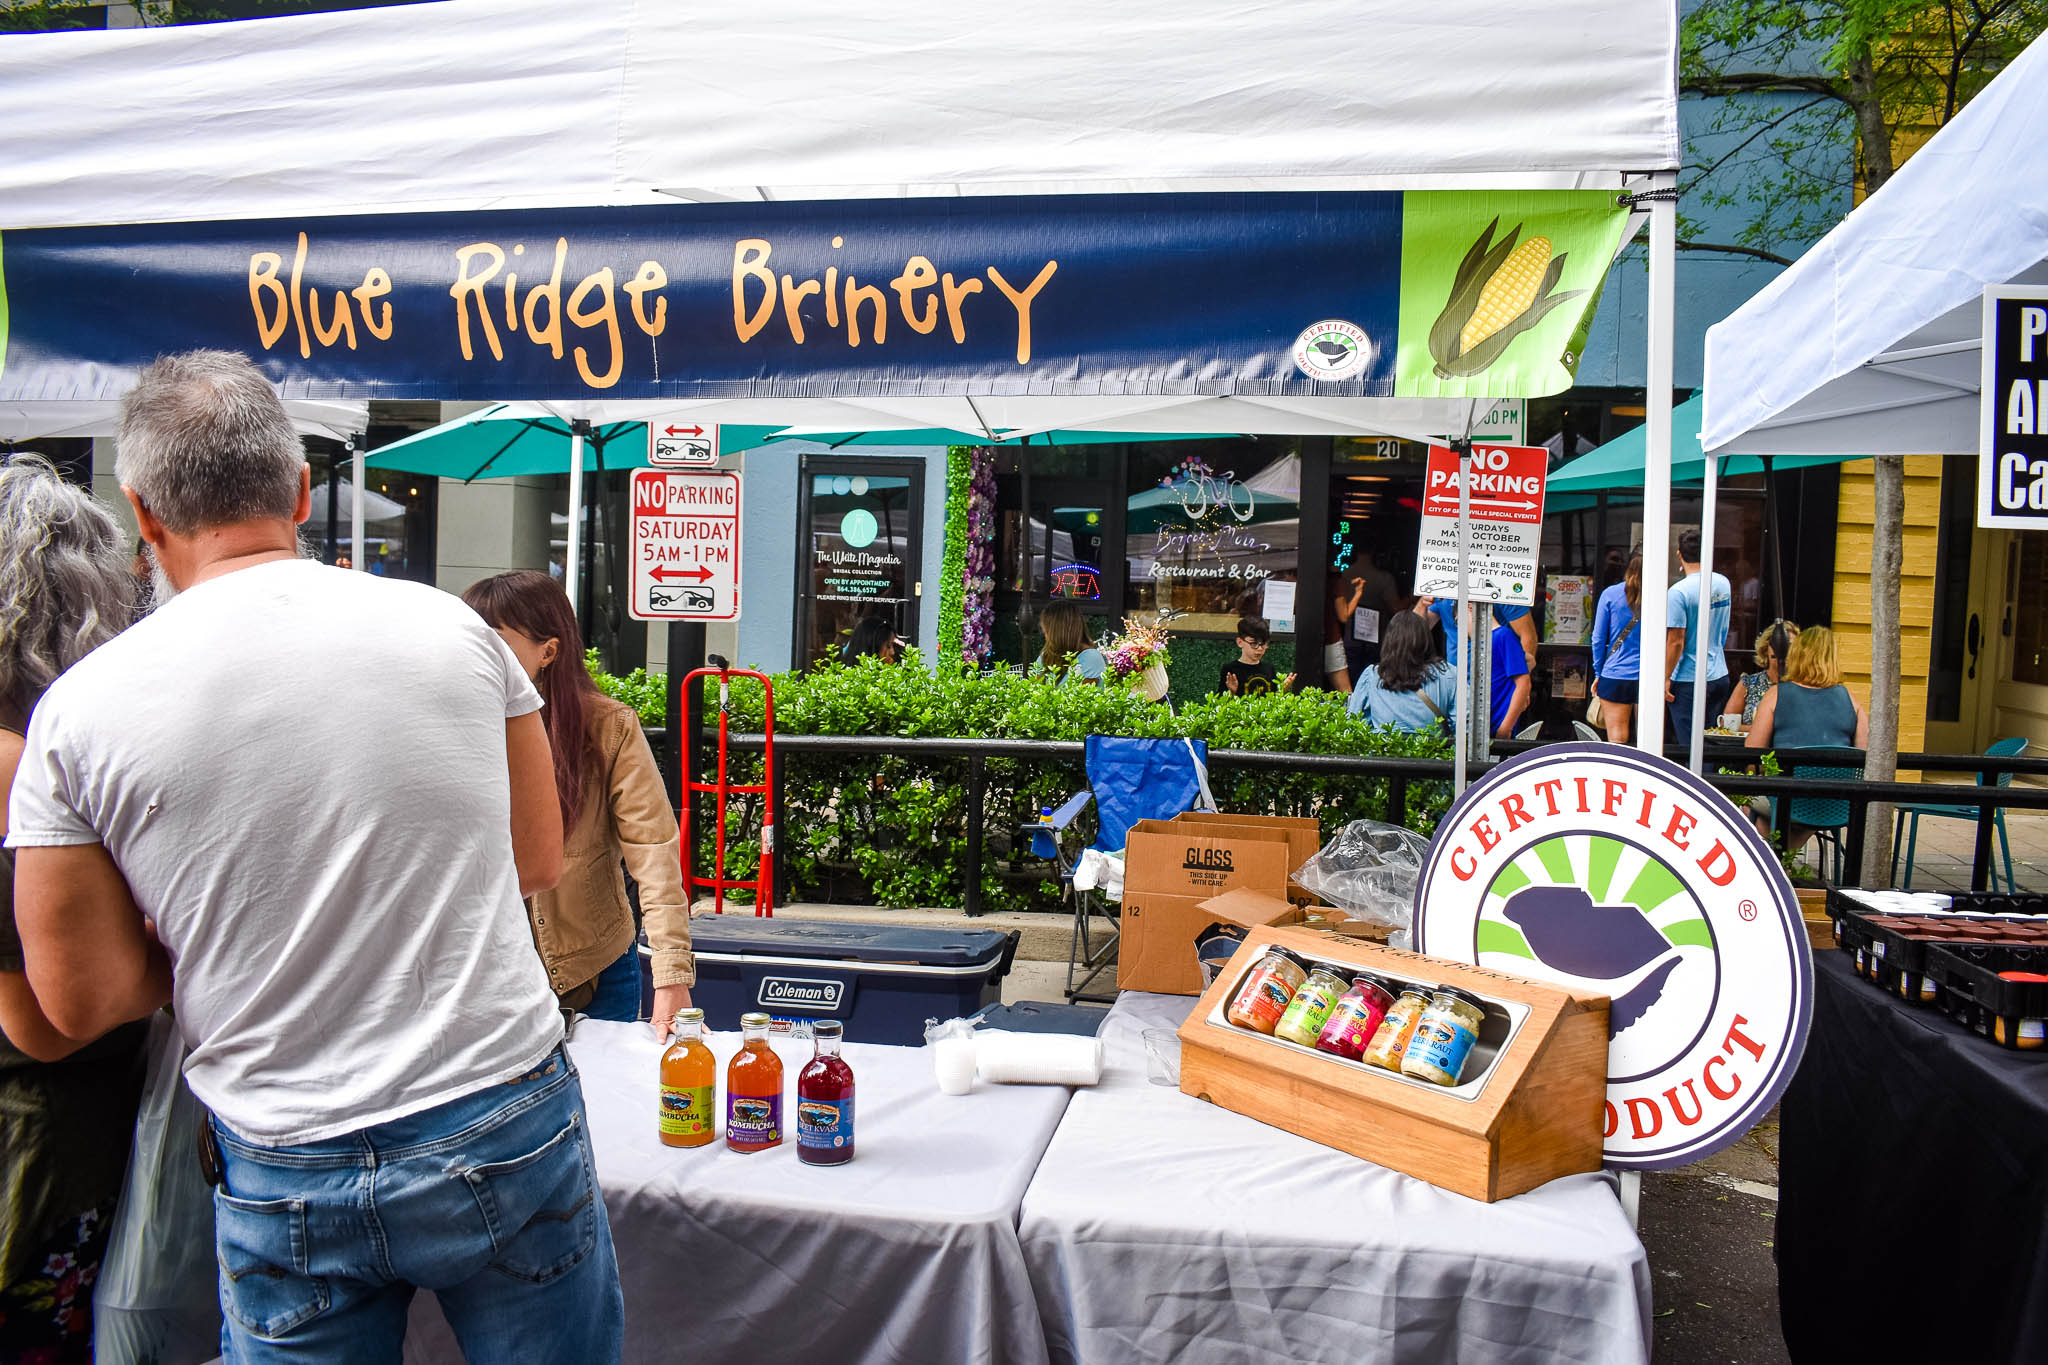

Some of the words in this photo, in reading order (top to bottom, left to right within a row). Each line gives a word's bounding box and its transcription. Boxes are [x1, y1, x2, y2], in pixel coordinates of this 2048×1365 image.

[248, 231, 393, 360] Blue
[449, 236, 668, 390] Ridge
[1303, 323, 1364, 342] CERTIFIED
[2020, 306, 2048, 363] P
[1297, 352, 1321, 377] SOUTH
[1502, 410, 1518, 424] PM
[1378, 440, 1399, 458] 20
[1470, 448, 1510, 471] NO
[1431, 470, 1540, 495] PARKING
[636, 479, 665, 509] NO
[668, 485, 734, 505] PARKING
[1452, 508, 1487, 516] GNVILLE
[1488, 510, 1513, 518] SPECIAL
[1513, 512, 1537, 520] EVENTS
[639, 520, 734, 541] SATURDAY
[1453, 521, 1510, 533] SURDAYS
[1426, 539, 1450, 547] FROM
[1485, 543, 1497, 551] TO
[1499, 545, 1530, 553] 2:00PM
[1472, 532, 1521, 543] OCTOBER
[815, 550, 832, 564] The
[832, 551, 857, 565] White
[858, 551, 901, 568] Magnolia
[1422, 556, 1460, 565] VIOLATO
[1469, 559, 1488, 568] WILL
[1503, 562, 1532, 571] TOWED
[1148, 561, 1226, 578] Restaurant
[1227, 563, 1241, 579] &
[1243, 563, 1272, 580] Bar
[1435, 565, 1459, 573] ORDE
[1480, 568, 1499, 576] CITY
[1501, 570, 1532, 579] POLICE
[849, 579, 891, 587] APPOINTMENT
[1450, 777, 1737, 887] CERTIFIED
[1186, 847, 1233, 867] GLASS
[1190, 871, 1203, 879] THIS
[1191, 878, 1207, 886] WITH
[1207, 879, 1224, 887] CARE
[1127, 906, 1141, 917] 12
[767, 981, 822, 1000] Coleman
[1604, 1013, 1768, 1140] DUCT
[659, 1111, 700, 1122] OMBUCHA
[728, 1118, 775, 1131] KOMBUCHA
[799, 1121, 814, 1131] BEET
[814, 1125, 839, 1133] KVASS
